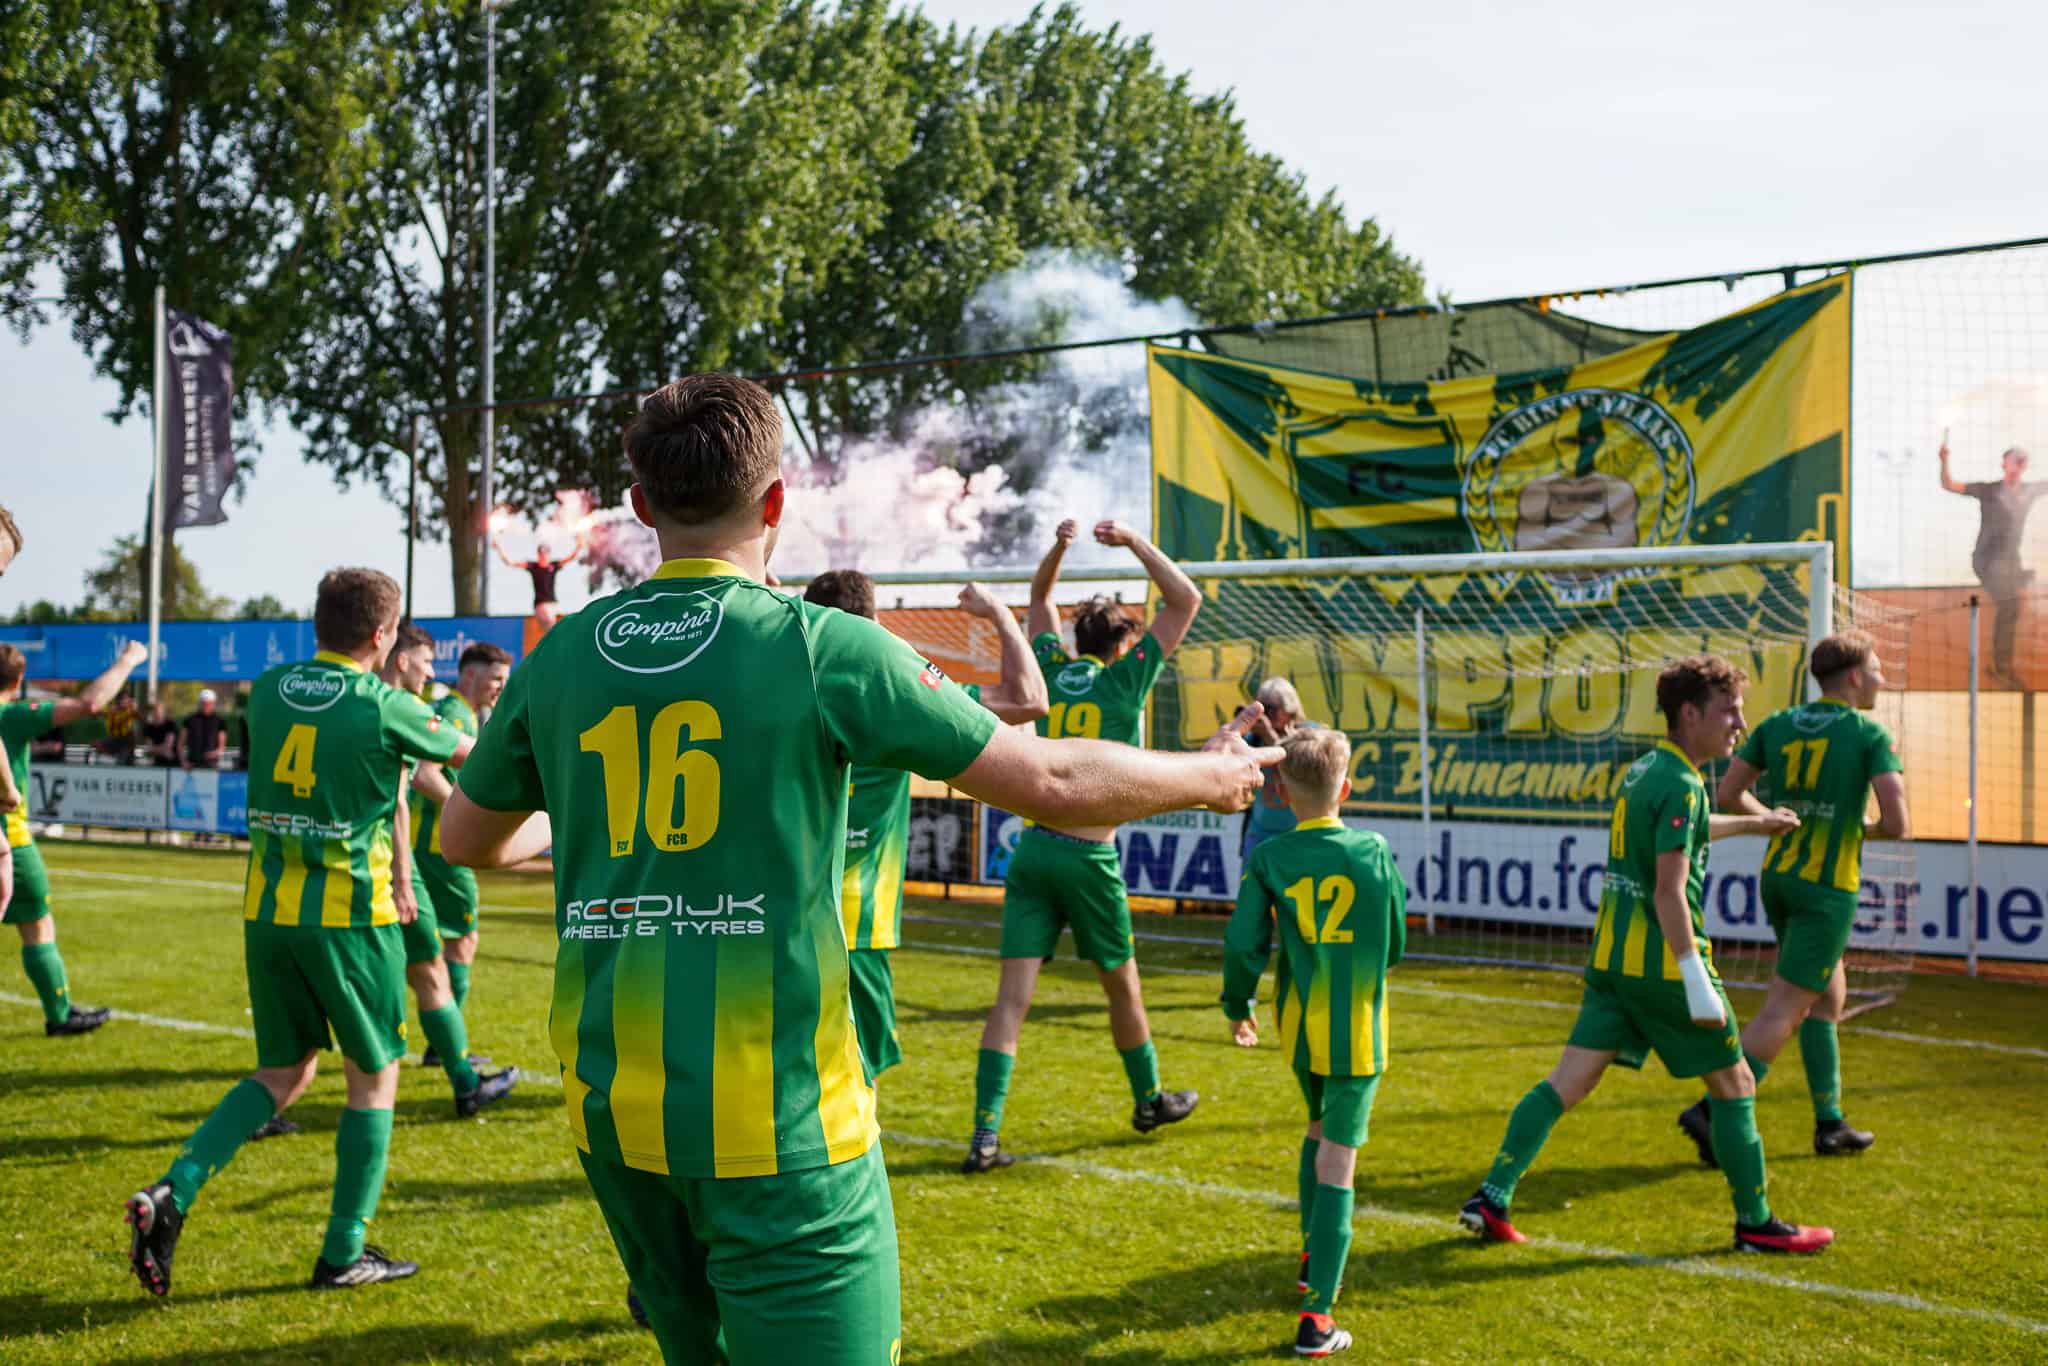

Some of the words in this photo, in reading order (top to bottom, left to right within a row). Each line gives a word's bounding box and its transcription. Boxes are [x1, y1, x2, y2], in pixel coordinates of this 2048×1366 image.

[1347, 463, 1407, 495] FC
[604, 609, 712, 647] Campina
[283, 672, 341, 696] Campina
[1048, 702, 1102, 739] 19
[272, 722, 318, 799] 4
[579, 700, 722, 857] 16
[1350, 741, 1381, 794] C
[1393, 741, 1629, 799] Binnenma
[1781, 738, 1829, 790] 17
[666, 833, 688, 846] FCB
[1115, 831, 1229, 895] NA
[561, 923, 630, 940] WHEELS
[635, 920, 660, 937] &
[671, 920, 765, 936] TYRES
[1284, 874, 1355, 944] 12
